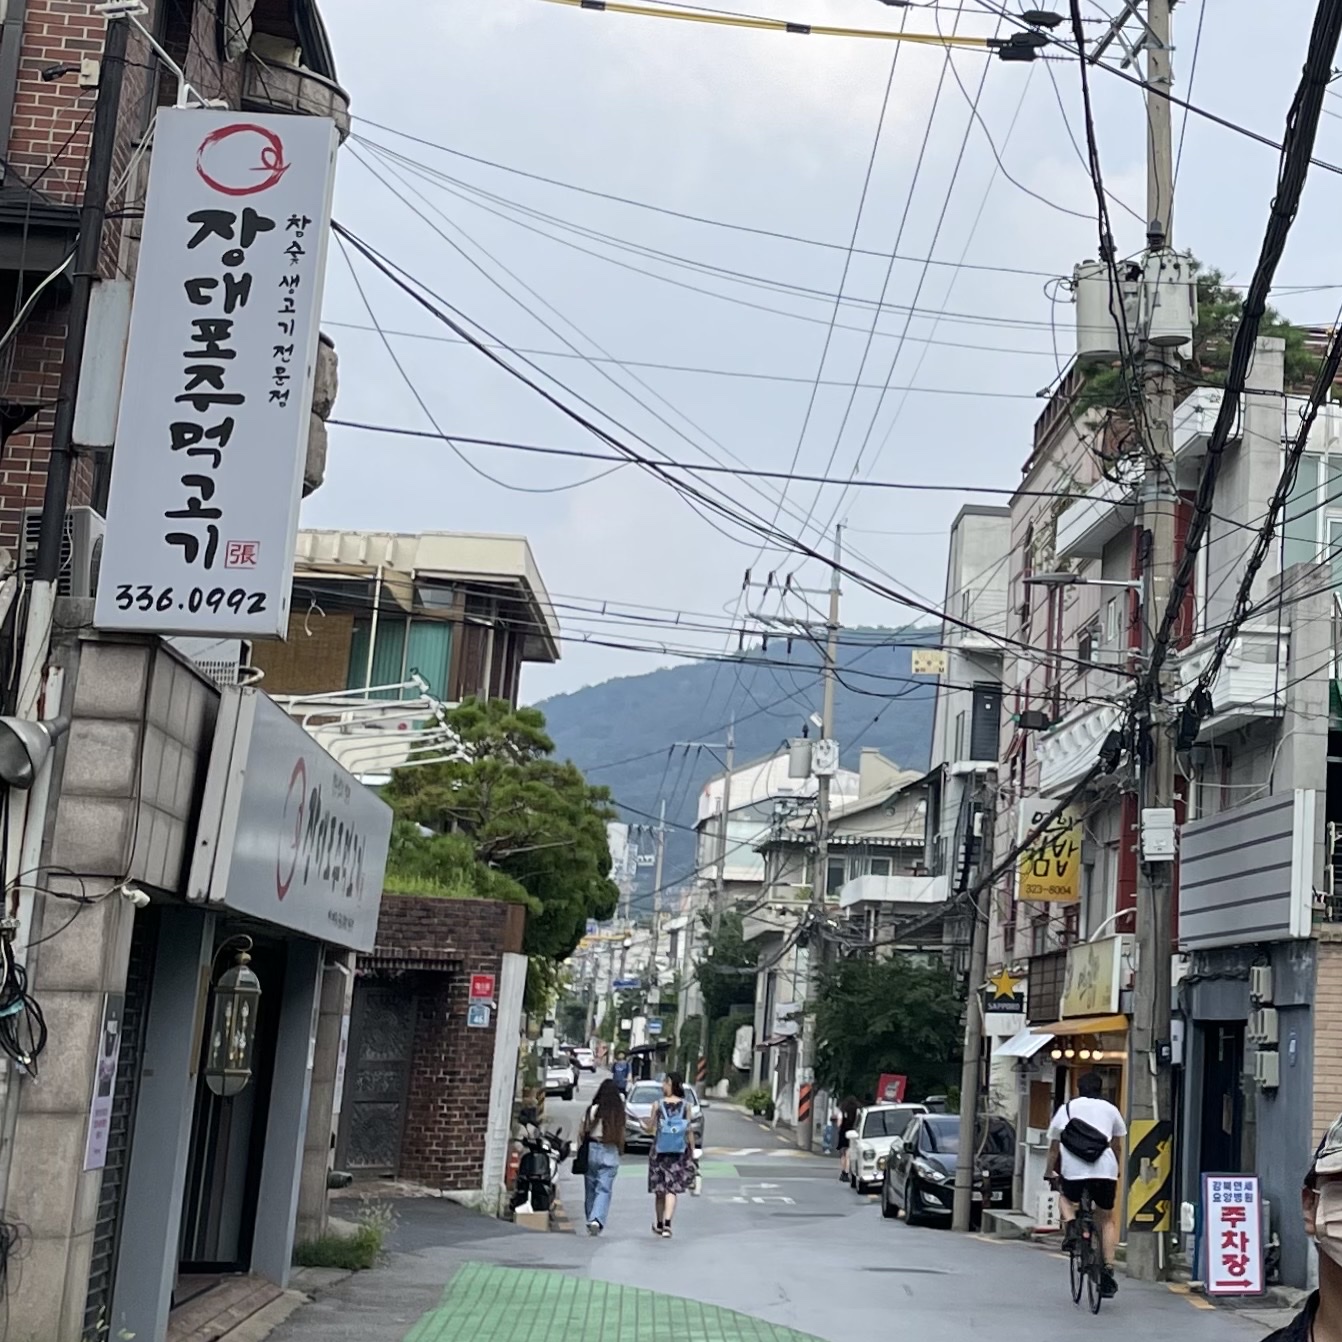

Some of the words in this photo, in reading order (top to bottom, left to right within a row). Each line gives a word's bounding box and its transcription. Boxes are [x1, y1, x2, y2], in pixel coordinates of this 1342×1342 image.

[284, 214, 312, 266] 참숯
[278, 274, 301, 337] 생고기
[164, 207, 276, 570] 장대포주먹고기
[116, 584, 267, 615] 336.0992
[1212, 1193, 1253, 1203] 요양병원
[1221, 1206, 1250, 1277] 주차장
